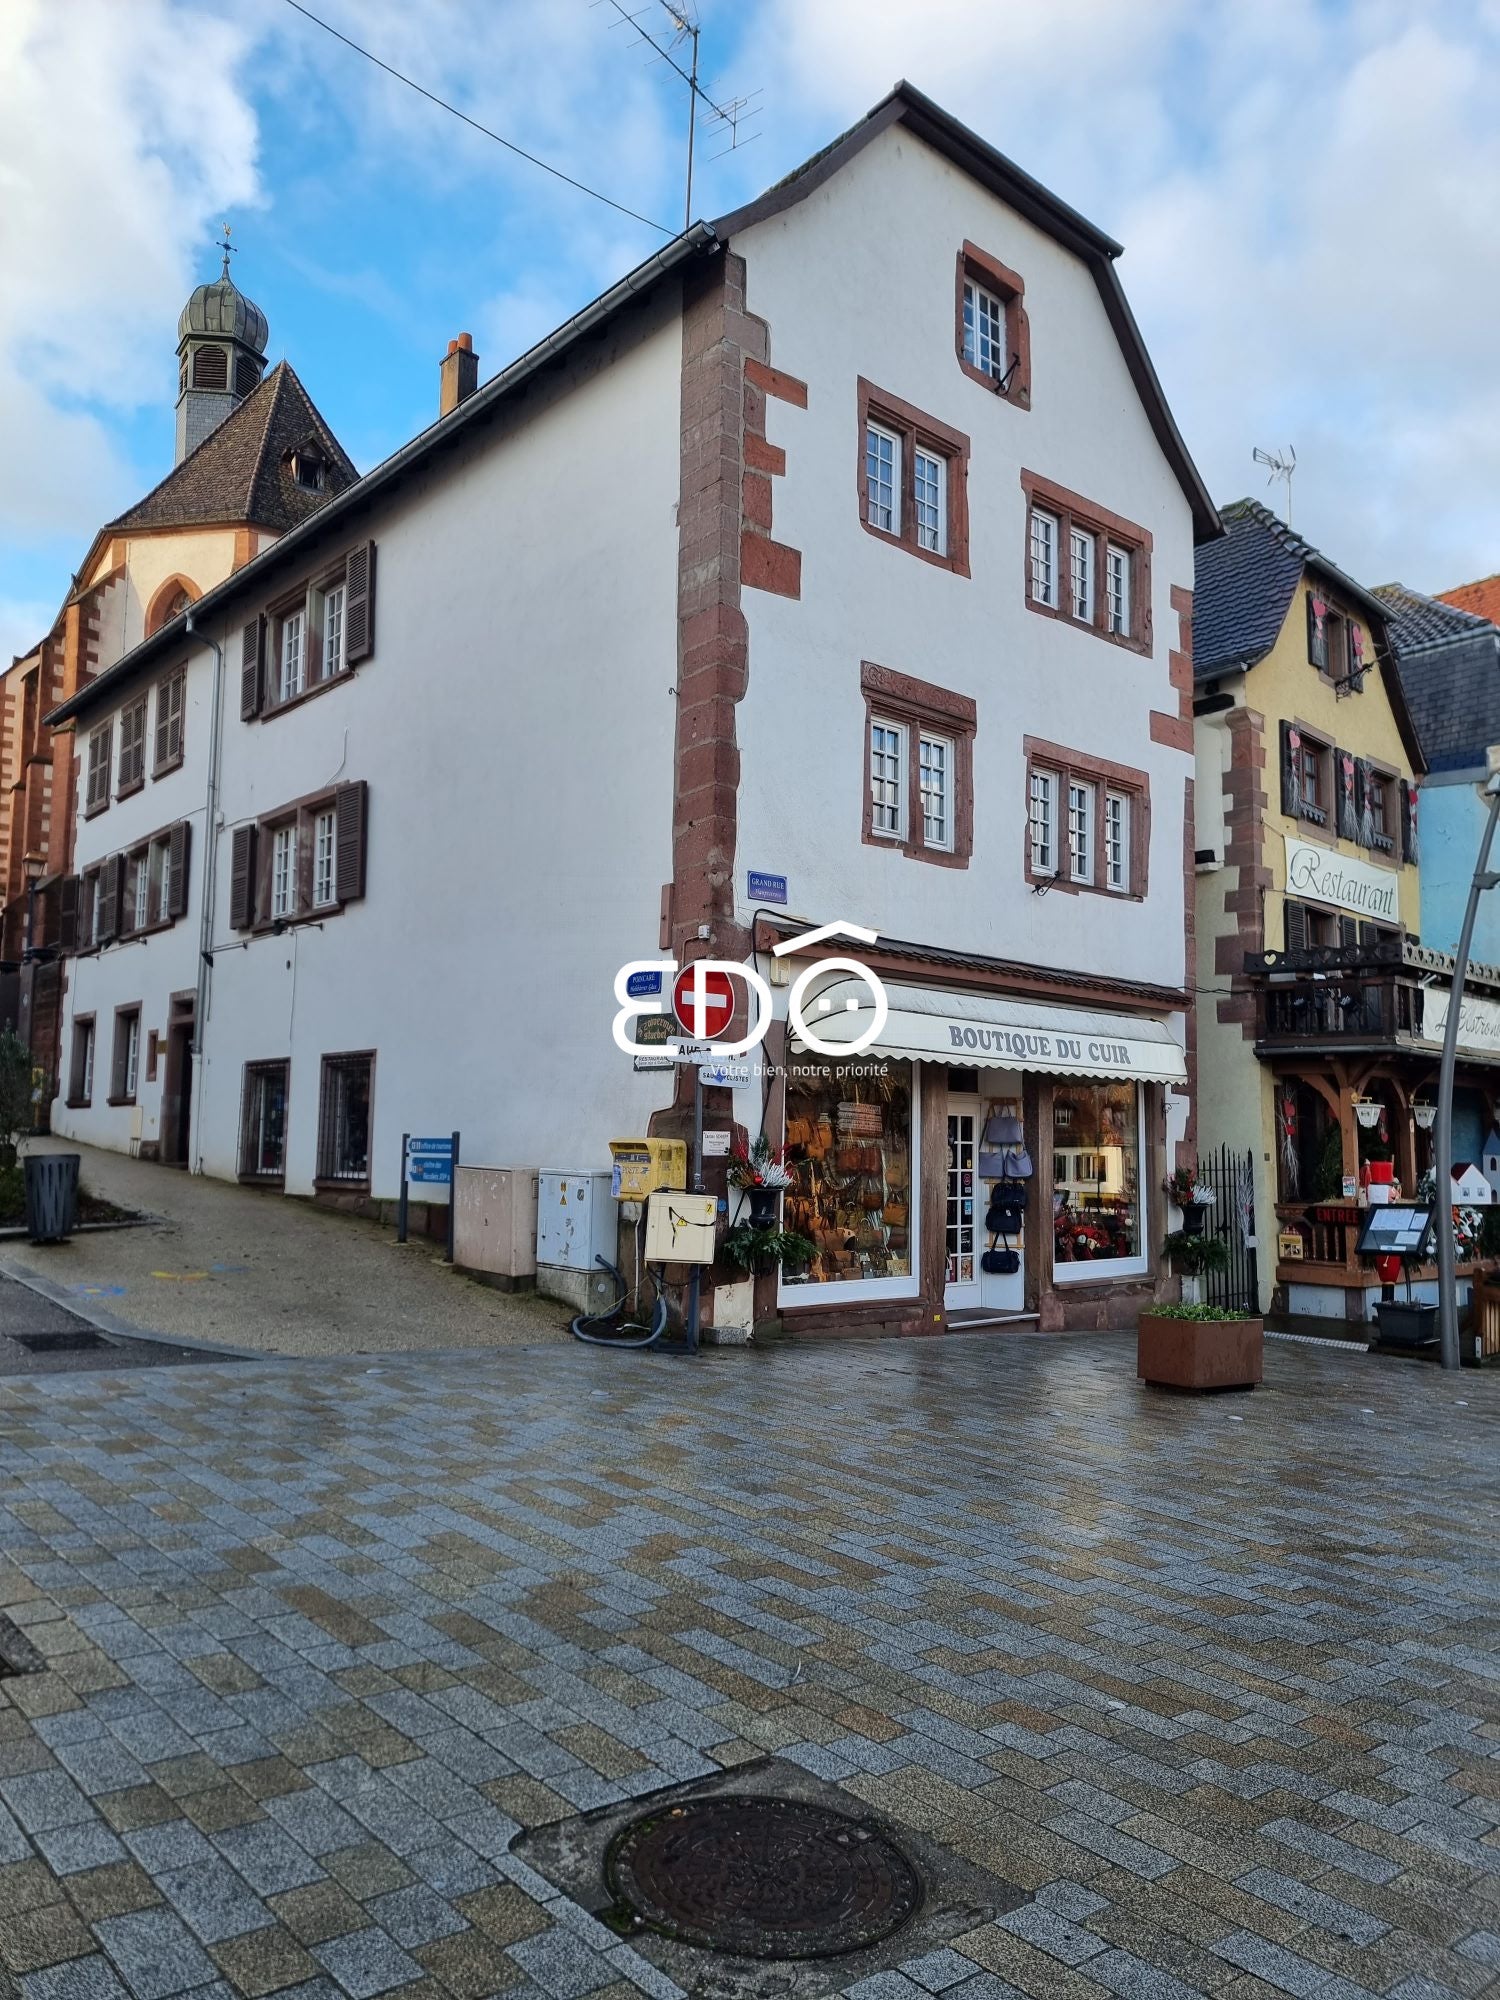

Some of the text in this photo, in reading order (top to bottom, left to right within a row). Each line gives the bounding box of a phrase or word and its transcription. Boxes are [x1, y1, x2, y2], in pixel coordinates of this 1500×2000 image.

[751, 877, 785, 890] GRAND RUE
[1290, 847, 1395, 915] Restaurant
[948, 1024, 1132, 1066] BOUTIQUE DU CUIR
